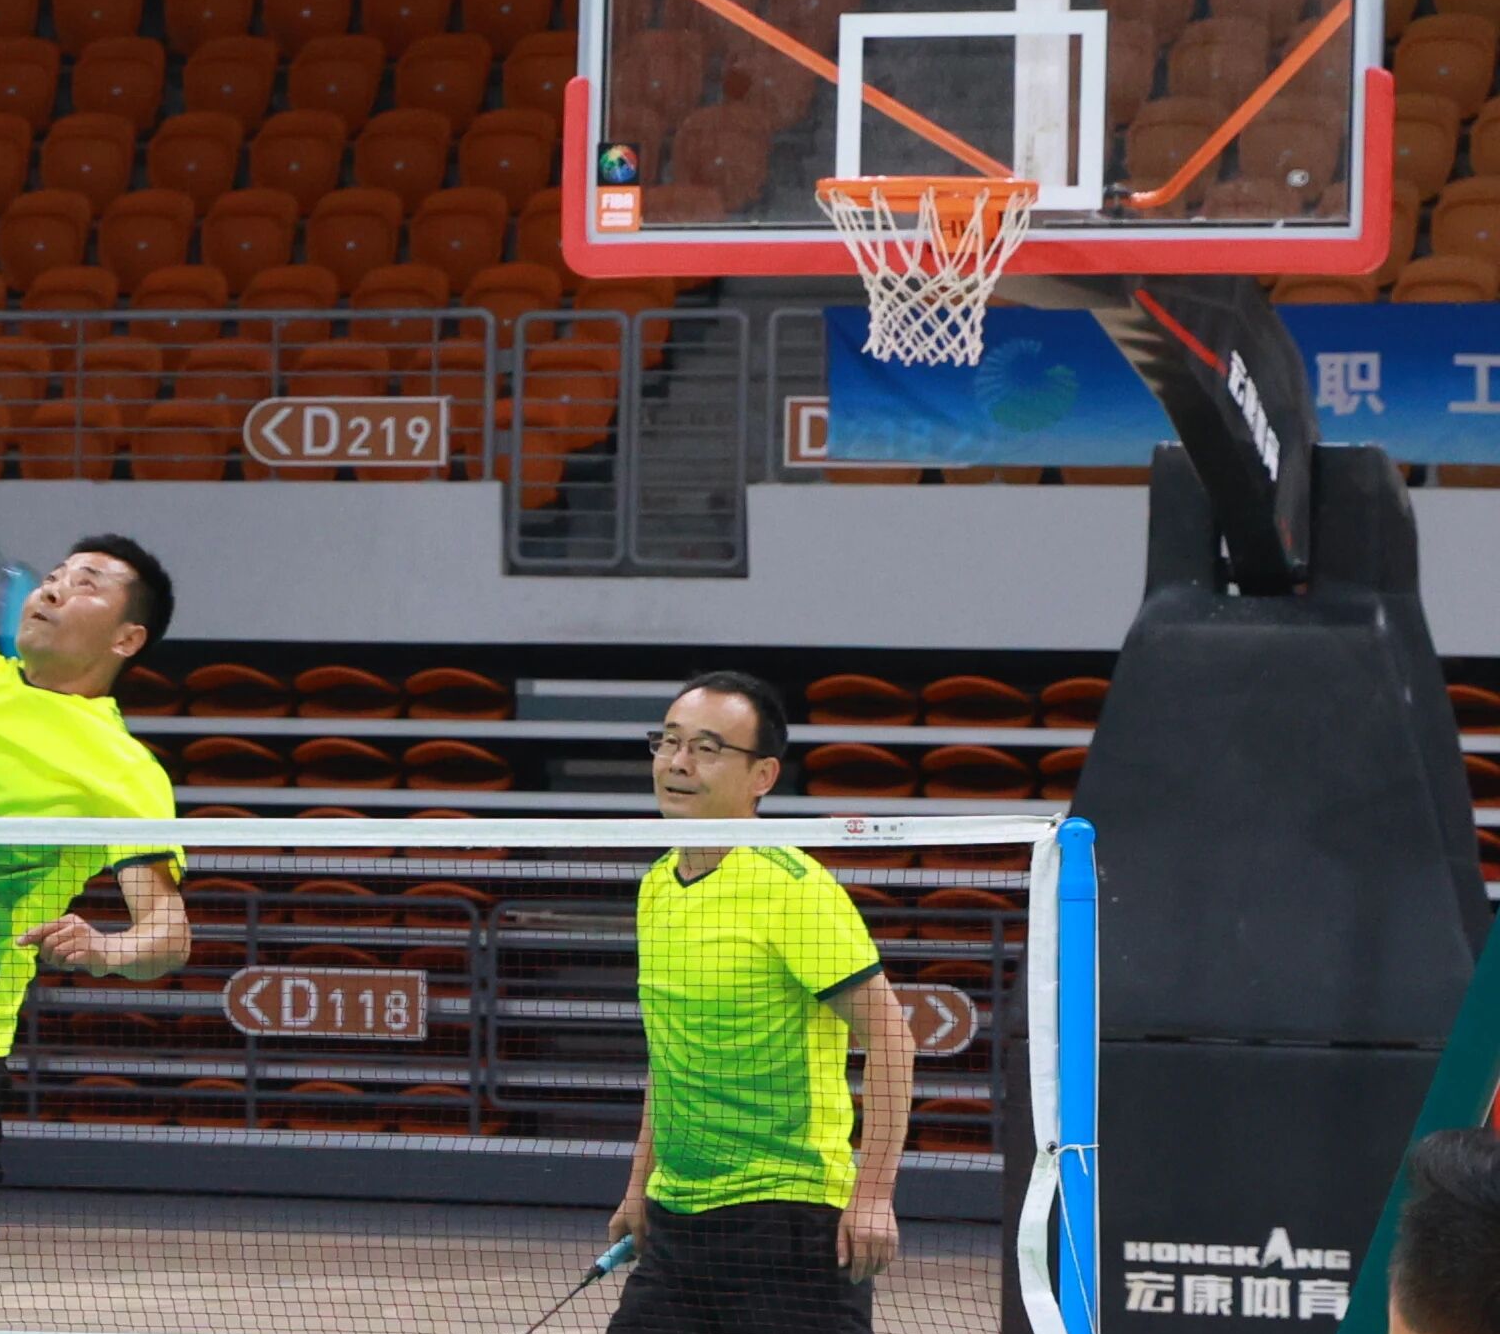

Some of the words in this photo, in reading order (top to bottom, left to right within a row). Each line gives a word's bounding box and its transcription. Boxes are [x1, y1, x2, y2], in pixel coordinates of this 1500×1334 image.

[303, 406, 433, 457] D219
[281, 978, 411, 1031] D118
[1123, 1227, 1351, 1270] HONGKANG
[1124, 1271, 1350, 1321] 宏康体育
